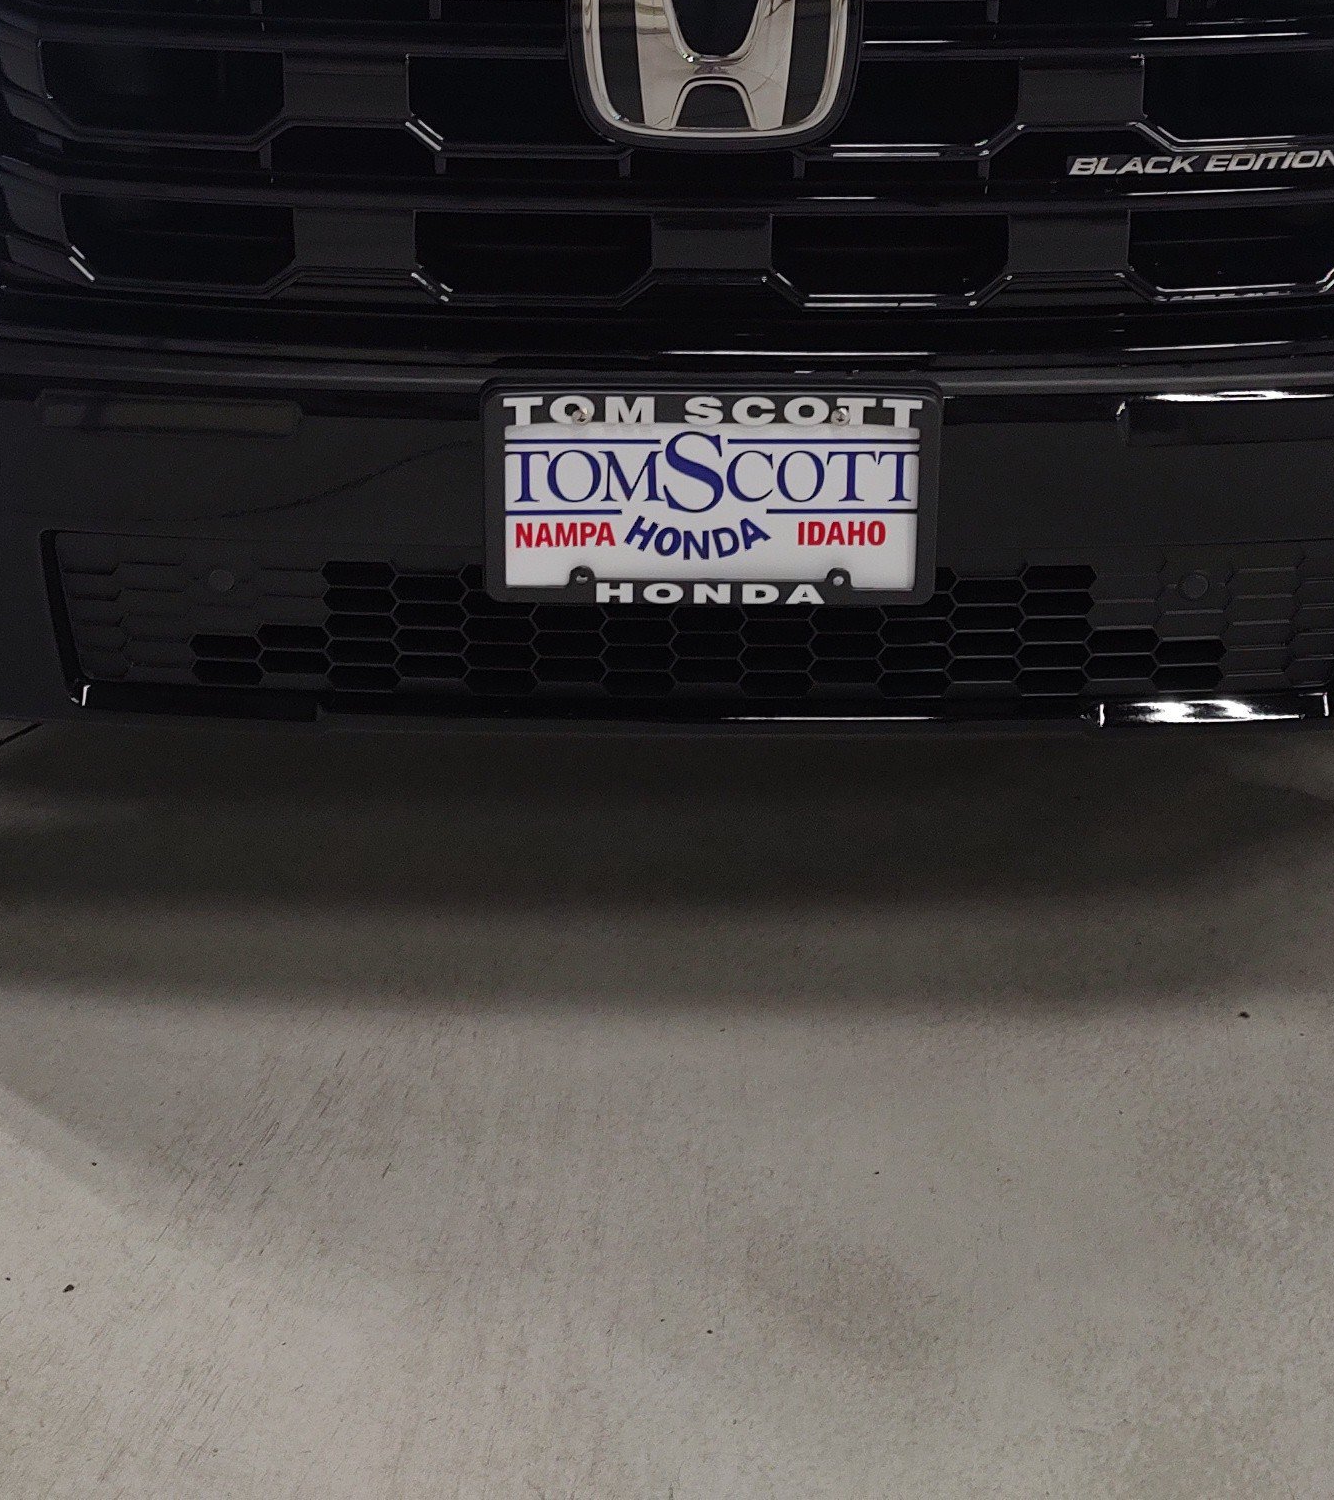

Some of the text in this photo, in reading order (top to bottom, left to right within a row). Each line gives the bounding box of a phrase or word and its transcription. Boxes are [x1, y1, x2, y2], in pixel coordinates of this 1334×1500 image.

[1068, 154, 1200, 176] BLACK
[502, 395, 923, 429] TOM SCOTT
[514, 522, 617, 549] NAMPA
[624, 515, 772, 561] HONDA
[797, 520, 887, 547] IDAHO
[595, 582, 826, 606] HONDA
